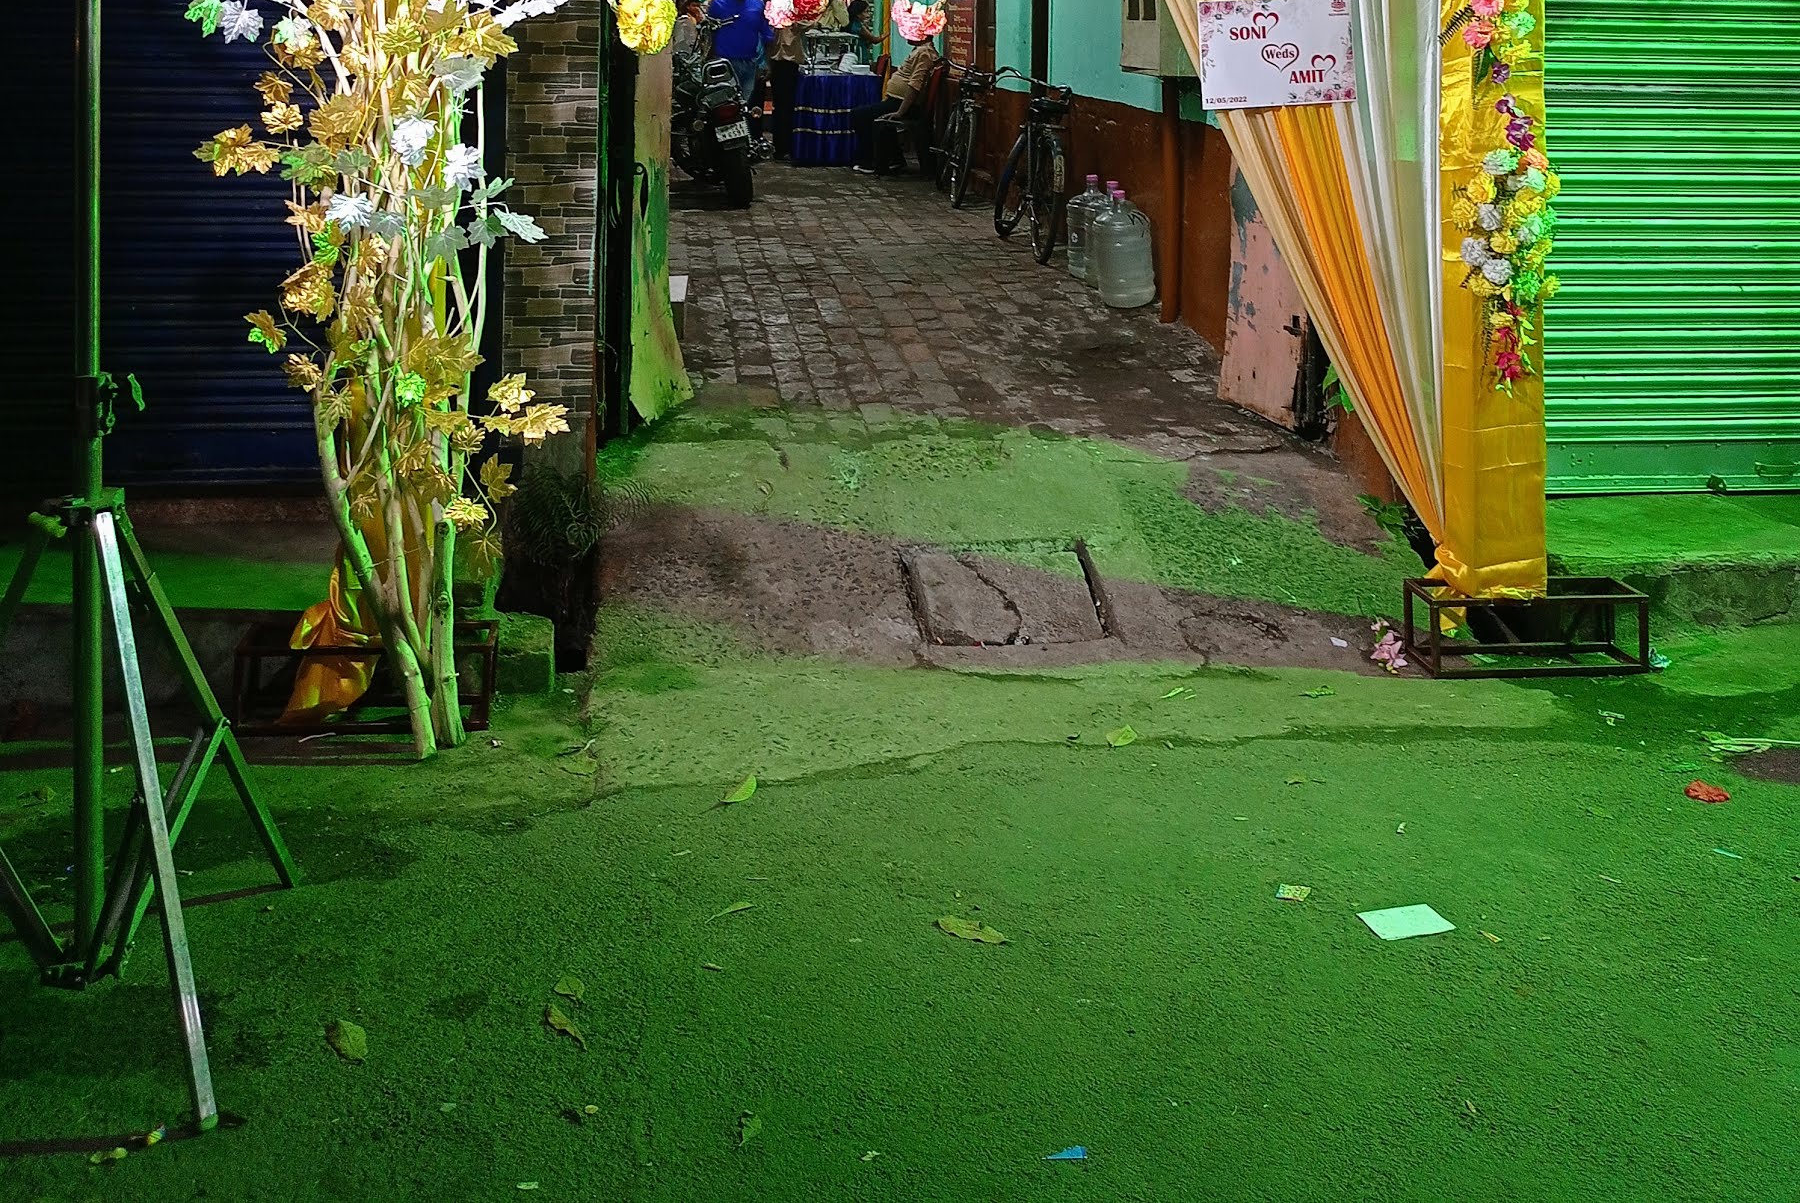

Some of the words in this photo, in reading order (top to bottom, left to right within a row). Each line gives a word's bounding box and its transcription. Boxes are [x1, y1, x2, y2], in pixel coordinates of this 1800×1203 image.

[1229, 25, 1267, 41] SONI
[1265, 48, 1295, 60] Weds
[1289, 69, 1326, 84] AMIT
[1205, 96, 1248, 105] 12/05/2022
